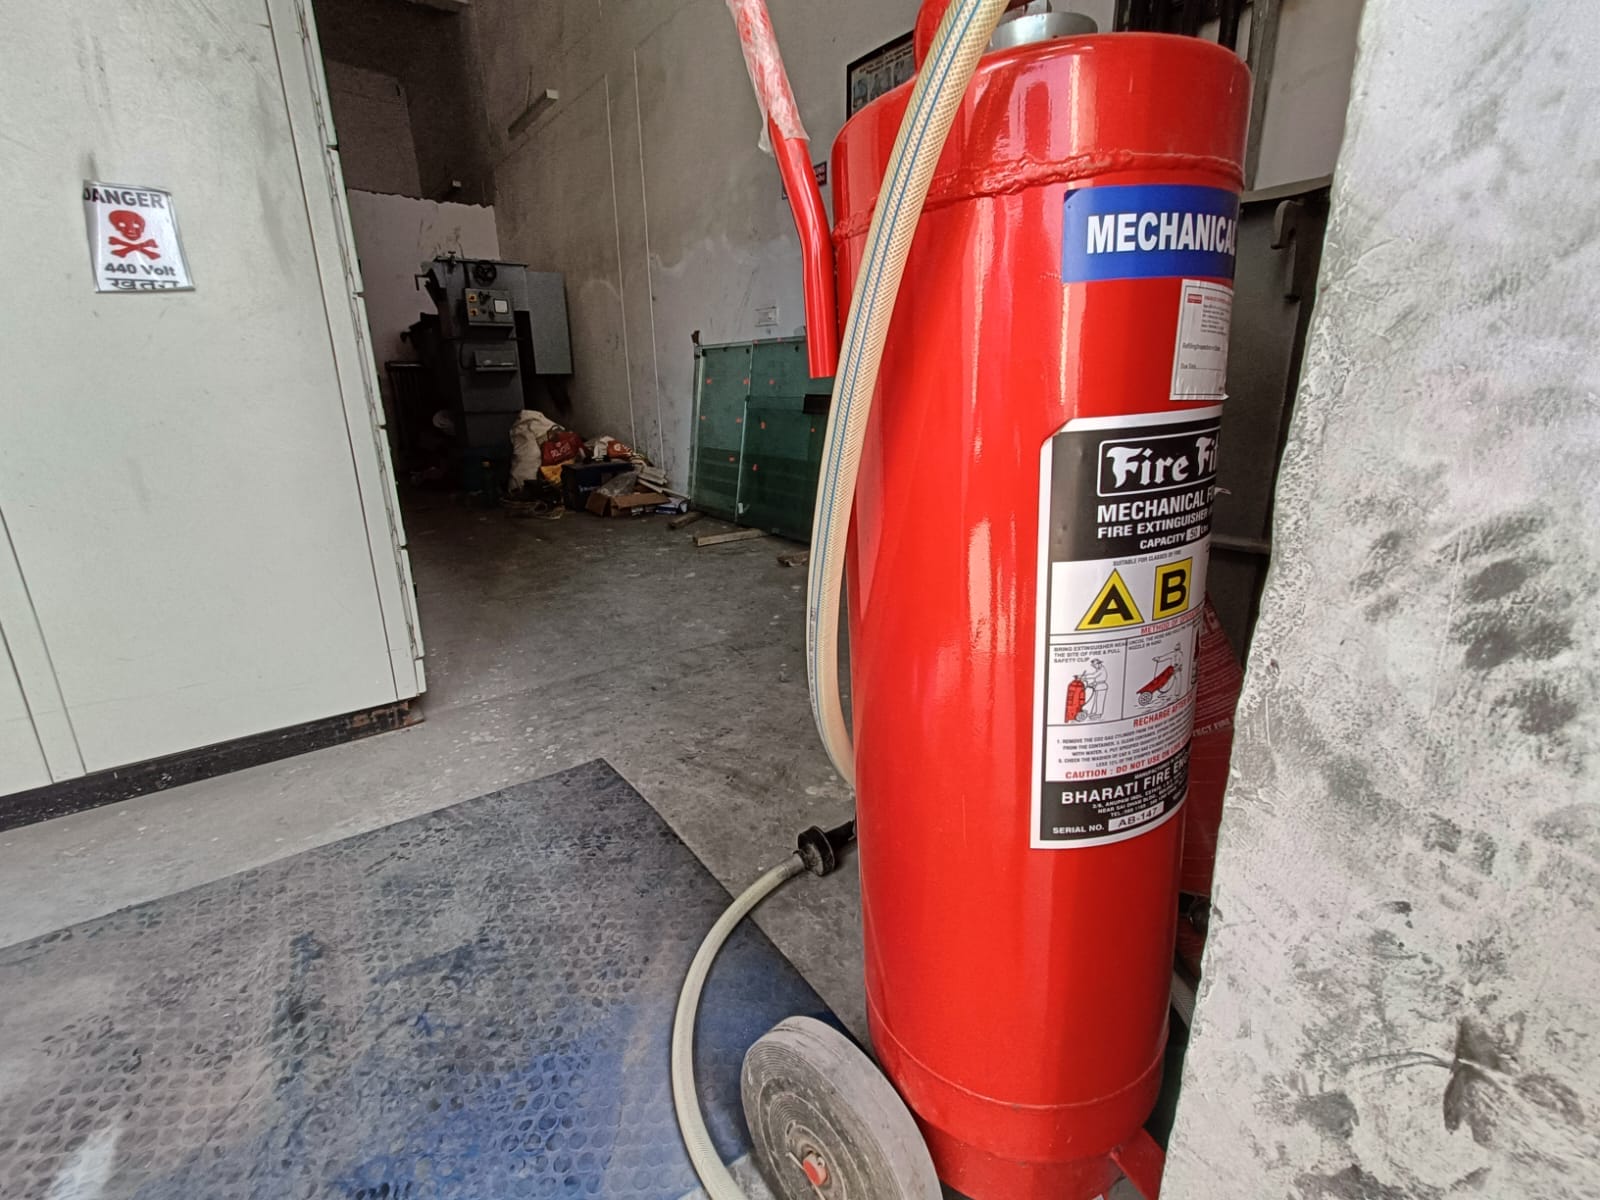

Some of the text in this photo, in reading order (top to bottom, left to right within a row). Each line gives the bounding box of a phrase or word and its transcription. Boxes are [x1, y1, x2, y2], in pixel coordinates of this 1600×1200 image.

[83, 188, 164, 208] DANGER
[104, 263, 176, 276] 440 Volt
[1106, 446, 1190, 488] Fire
[1097, 490, 1205, 523] MECHANICAL
[1097, 523, 1132, 539] FIRE
[1137, 508, 1208, 534] EXTINGUISHER
[1139, 532, 1187, 549] CAPACITY
[1088, 568, 1187, 624] A B
[1133, 708, 1170, 728] RECHARGE
[1065, 769, 1107, 779] CAUTION
[1116, 765, 1128, 774] DO
[1130, 760, 1145, 769] NOT
[1148, 754, 1160, 764] USE
[1061, 781, 1138, 804] BHARATI
[1144, 767, 1170, 790] FIRE
[1052, 825, 1086, 834] SERIAL
[1088, 824, 1104, 832] NO.
[1118, 806, 1158, 827] AB-147
